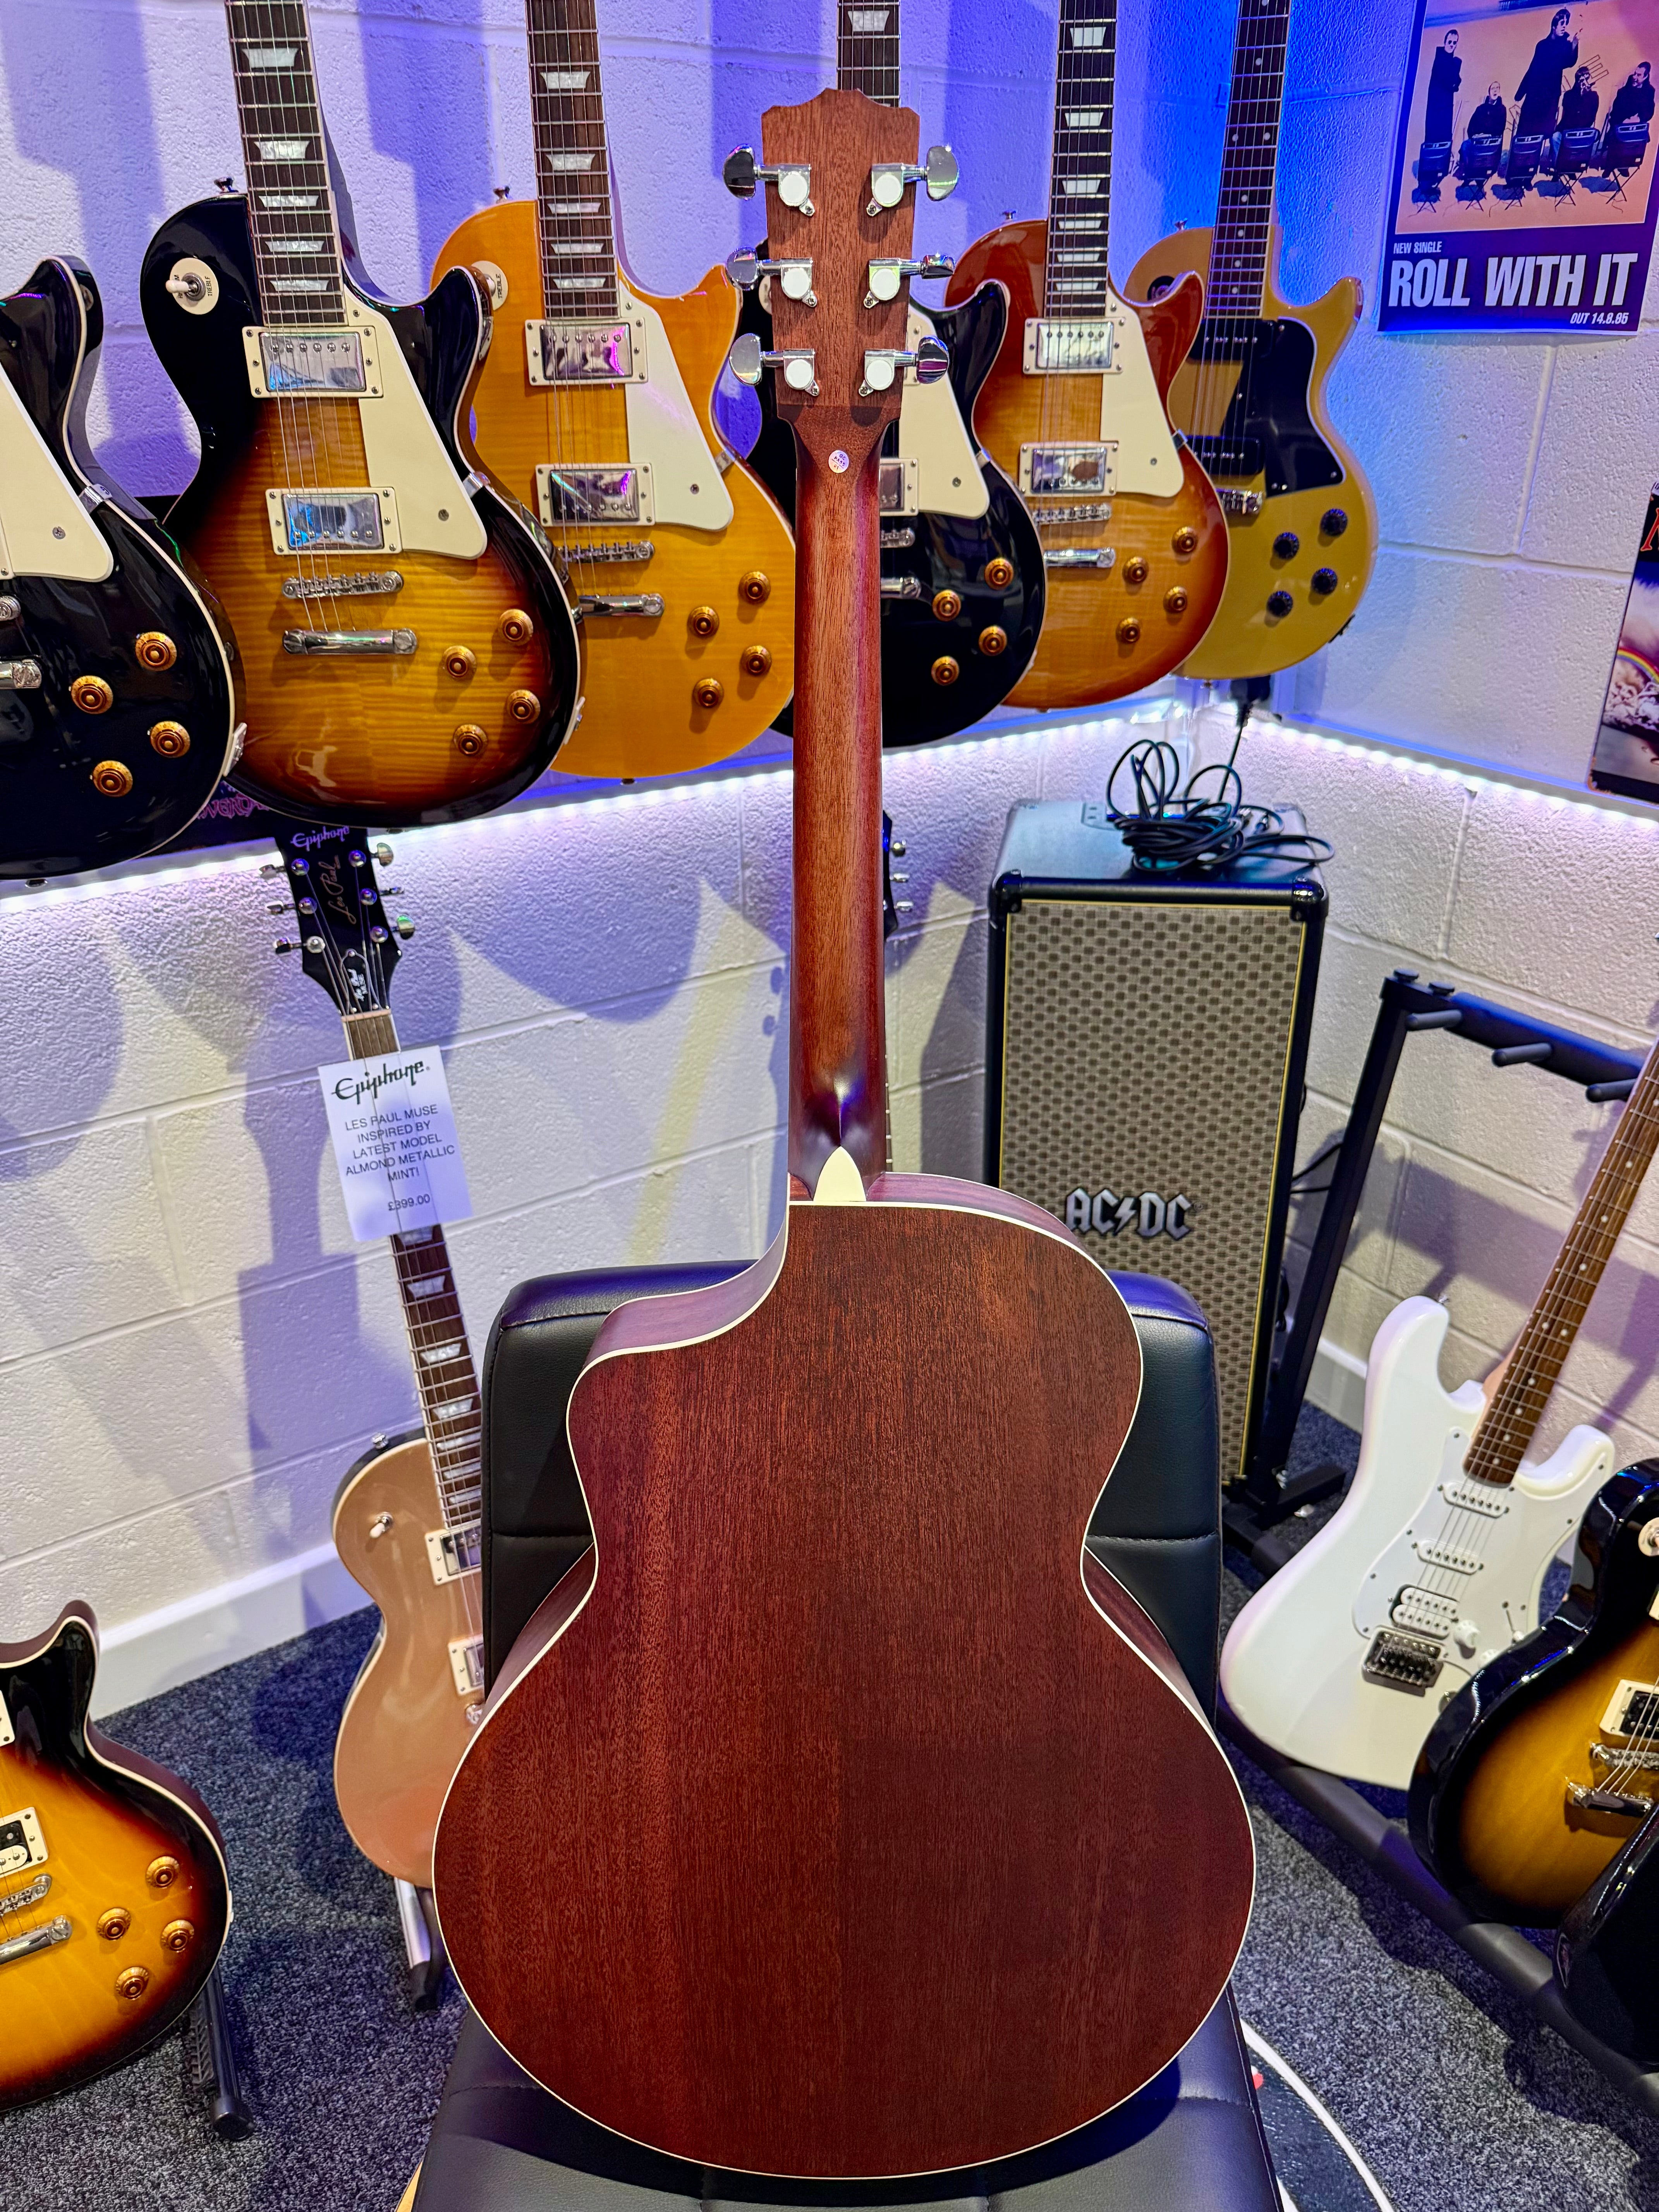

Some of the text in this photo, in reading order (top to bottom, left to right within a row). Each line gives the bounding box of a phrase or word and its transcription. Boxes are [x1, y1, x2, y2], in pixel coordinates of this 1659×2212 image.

[1393, 241, 1442, 254] NEW SINGLE
[1388, 253, 1638, 307] ROLL WITH IT
[1570, 312, 1590, 324] OUT
[290, 825, 350, 852] Epiphone
[331, 1061, 425, 1105] Epiphone
[345, 1104, 438, 1131] LES PAUL MUSE
[358, 1120, 431, 1143] INSPIRED BY
[353, 1133, 442, 1159] LATEST MODEL
[346, 1145, 455, 1176] ALMOND METALLIC
